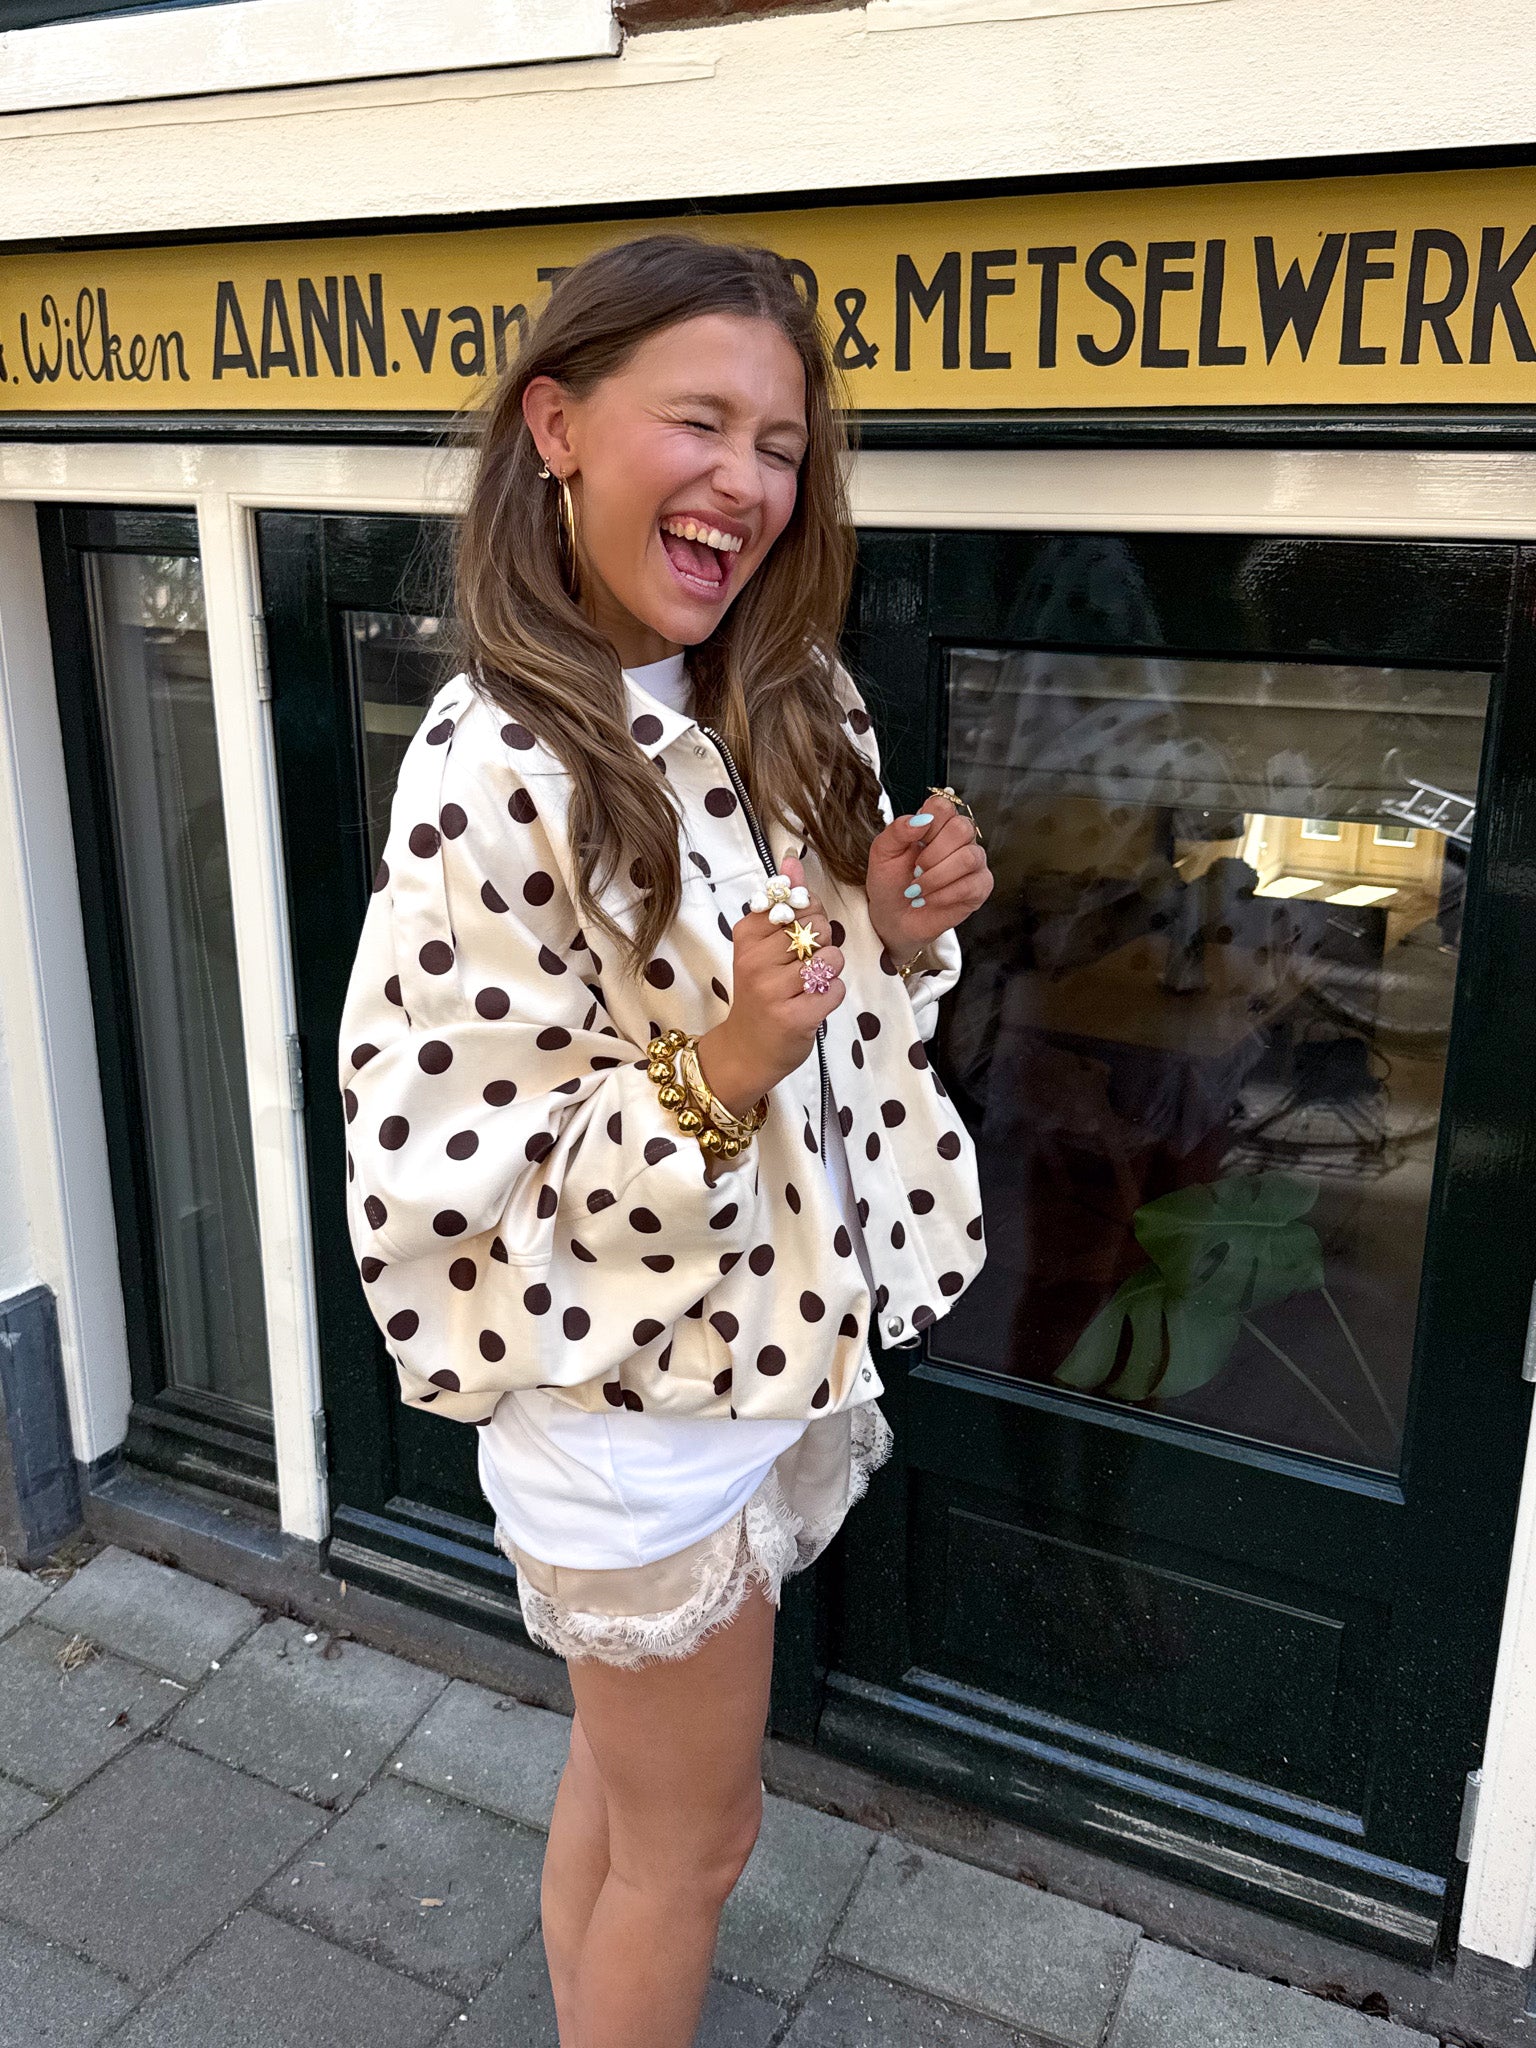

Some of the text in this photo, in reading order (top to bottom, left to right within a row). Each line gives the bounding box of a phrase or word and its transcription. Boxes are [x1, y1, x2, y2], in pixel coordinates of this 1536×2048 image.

[20, 287, 191, 384] Wilken
[834, 288, 880, 370] &
[895, 224, 1536, 371] METSELWERK
